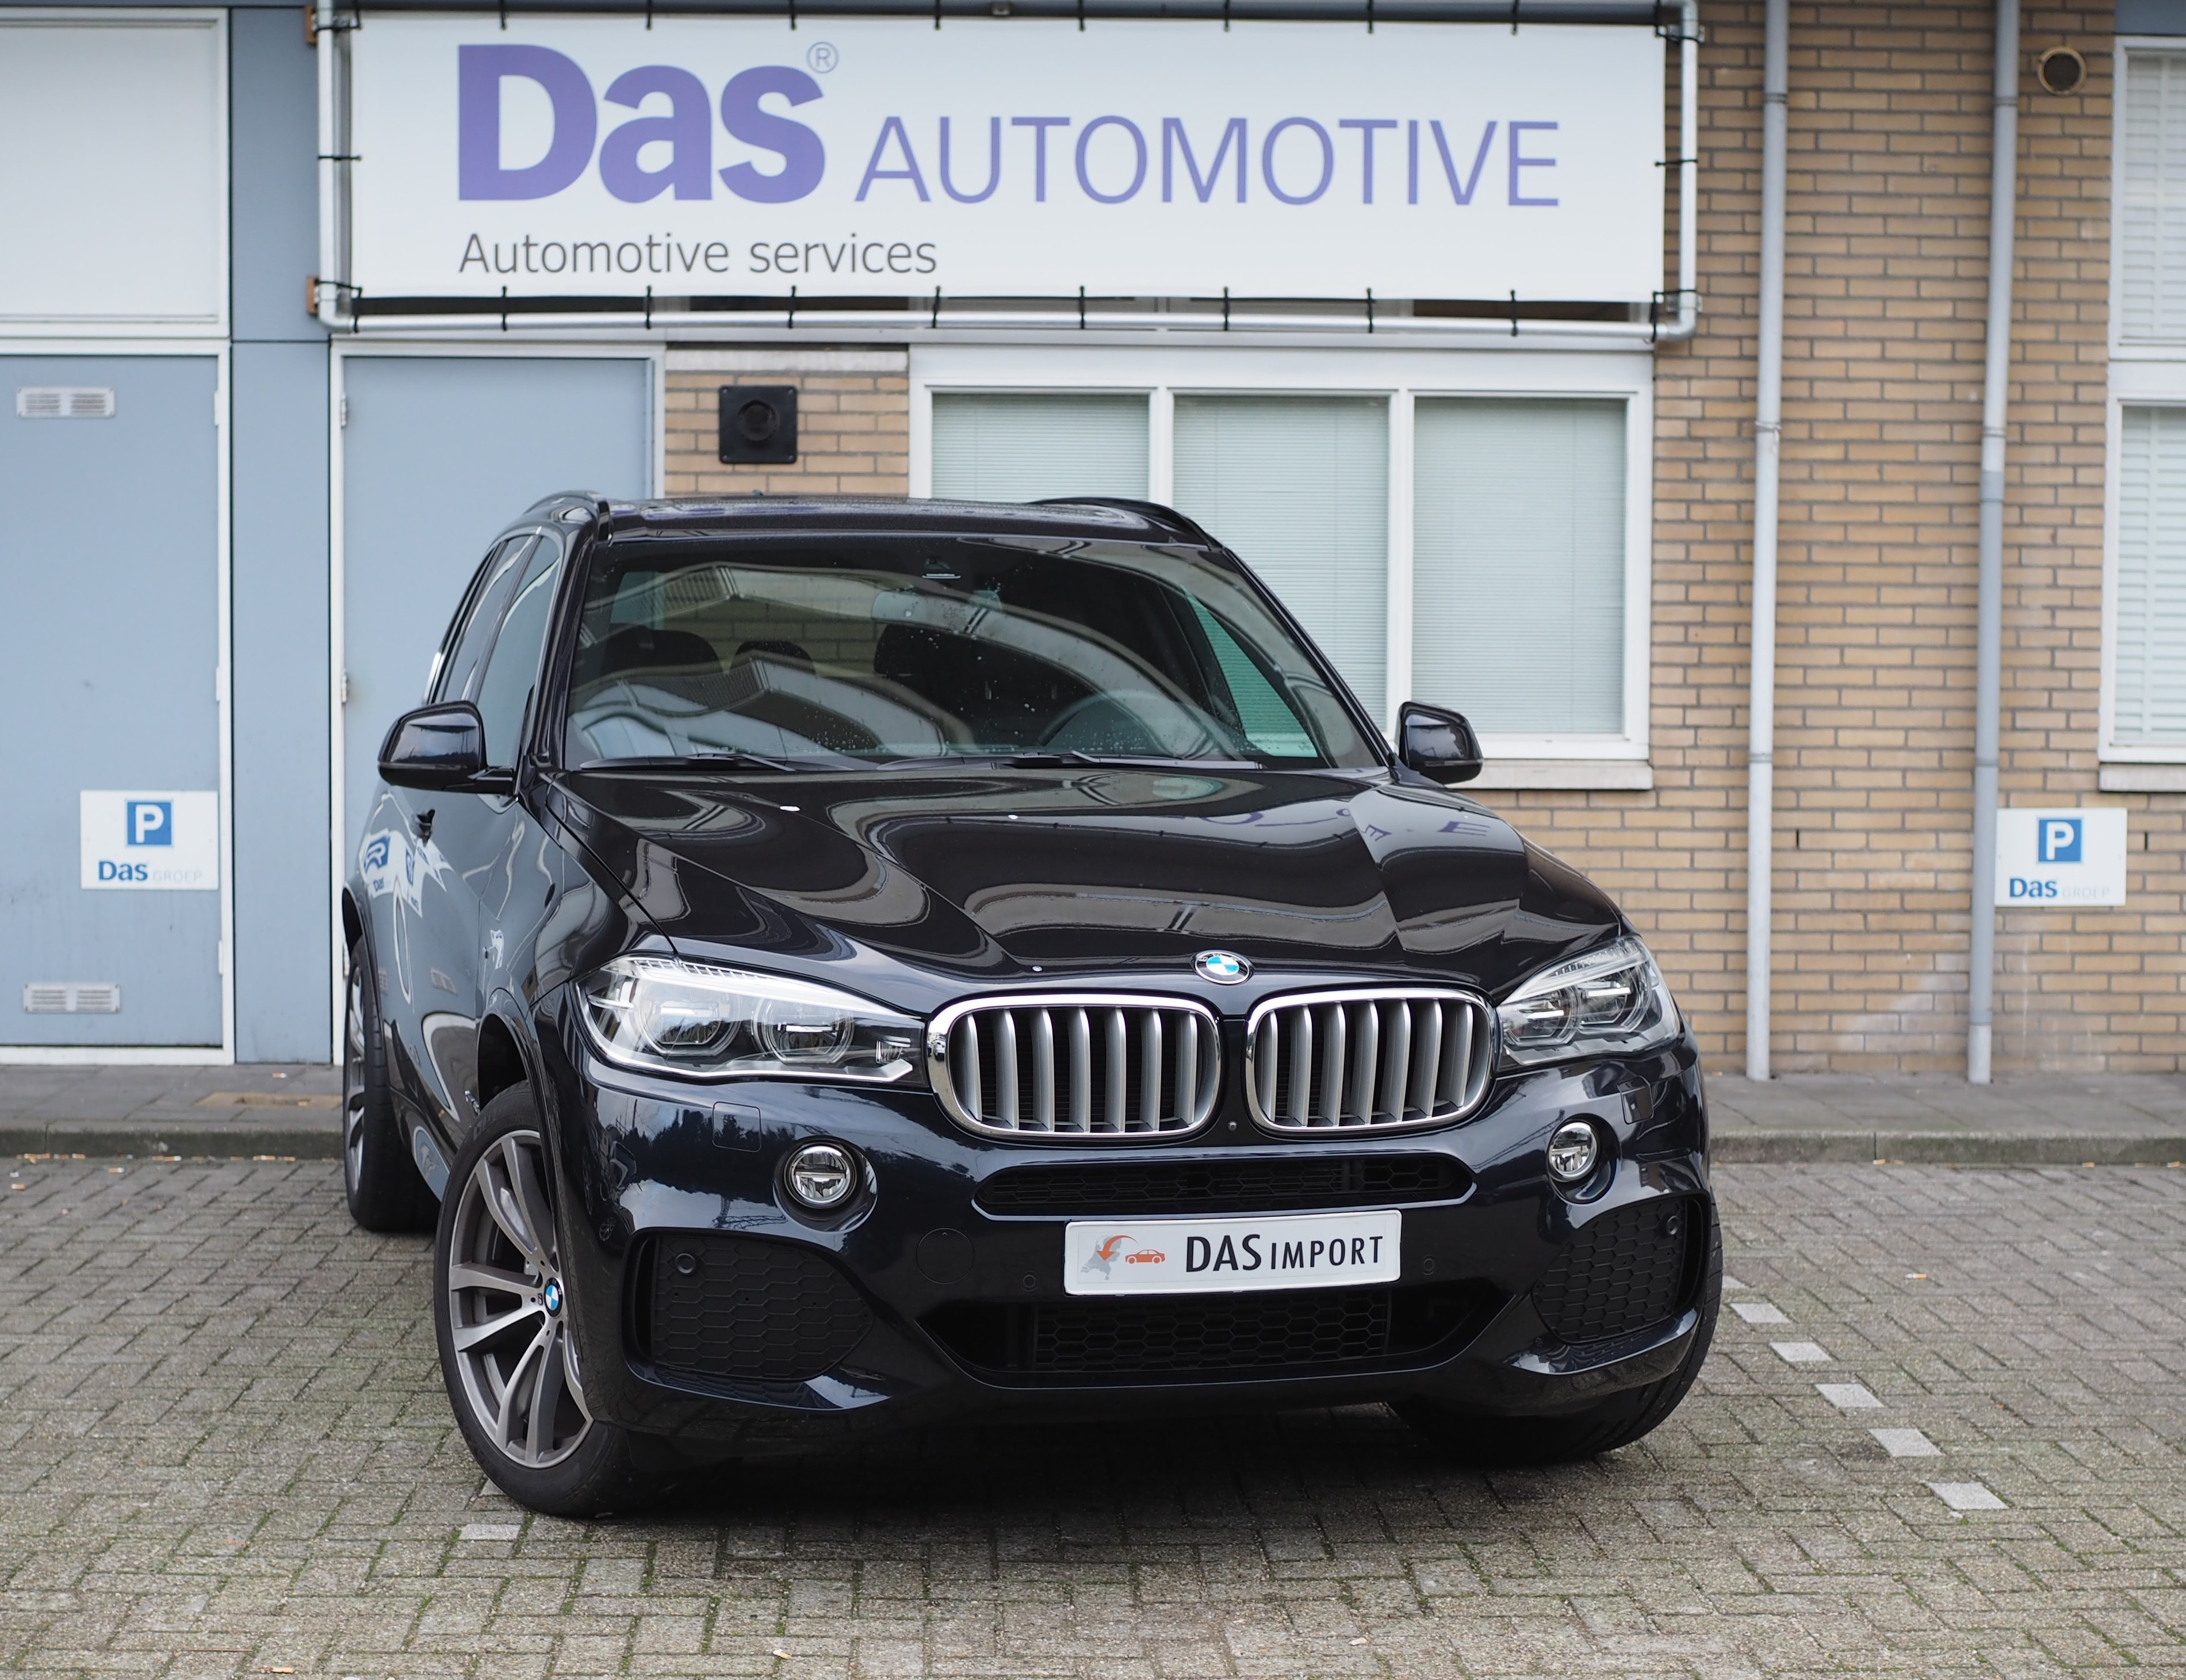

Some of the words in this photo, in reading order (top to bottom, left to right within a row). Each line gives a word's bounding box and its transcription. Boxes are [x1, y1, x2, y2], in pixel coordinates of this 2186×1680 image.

[855, 115, 1560, 206] AUTOMOTIVE
[459, 232, 729, 274] Automotive
[749, 232, 937, 274] services
[135, 804, 164, 844] P
[2046, 821, 2074, 861] P
[98, 860, 148, 881] Das
[2009, 878, 2058, 898] Das
[1185, 1234, 1262, 1273] DAS
[1270, 1235, 1383, 1270] IMPORT
